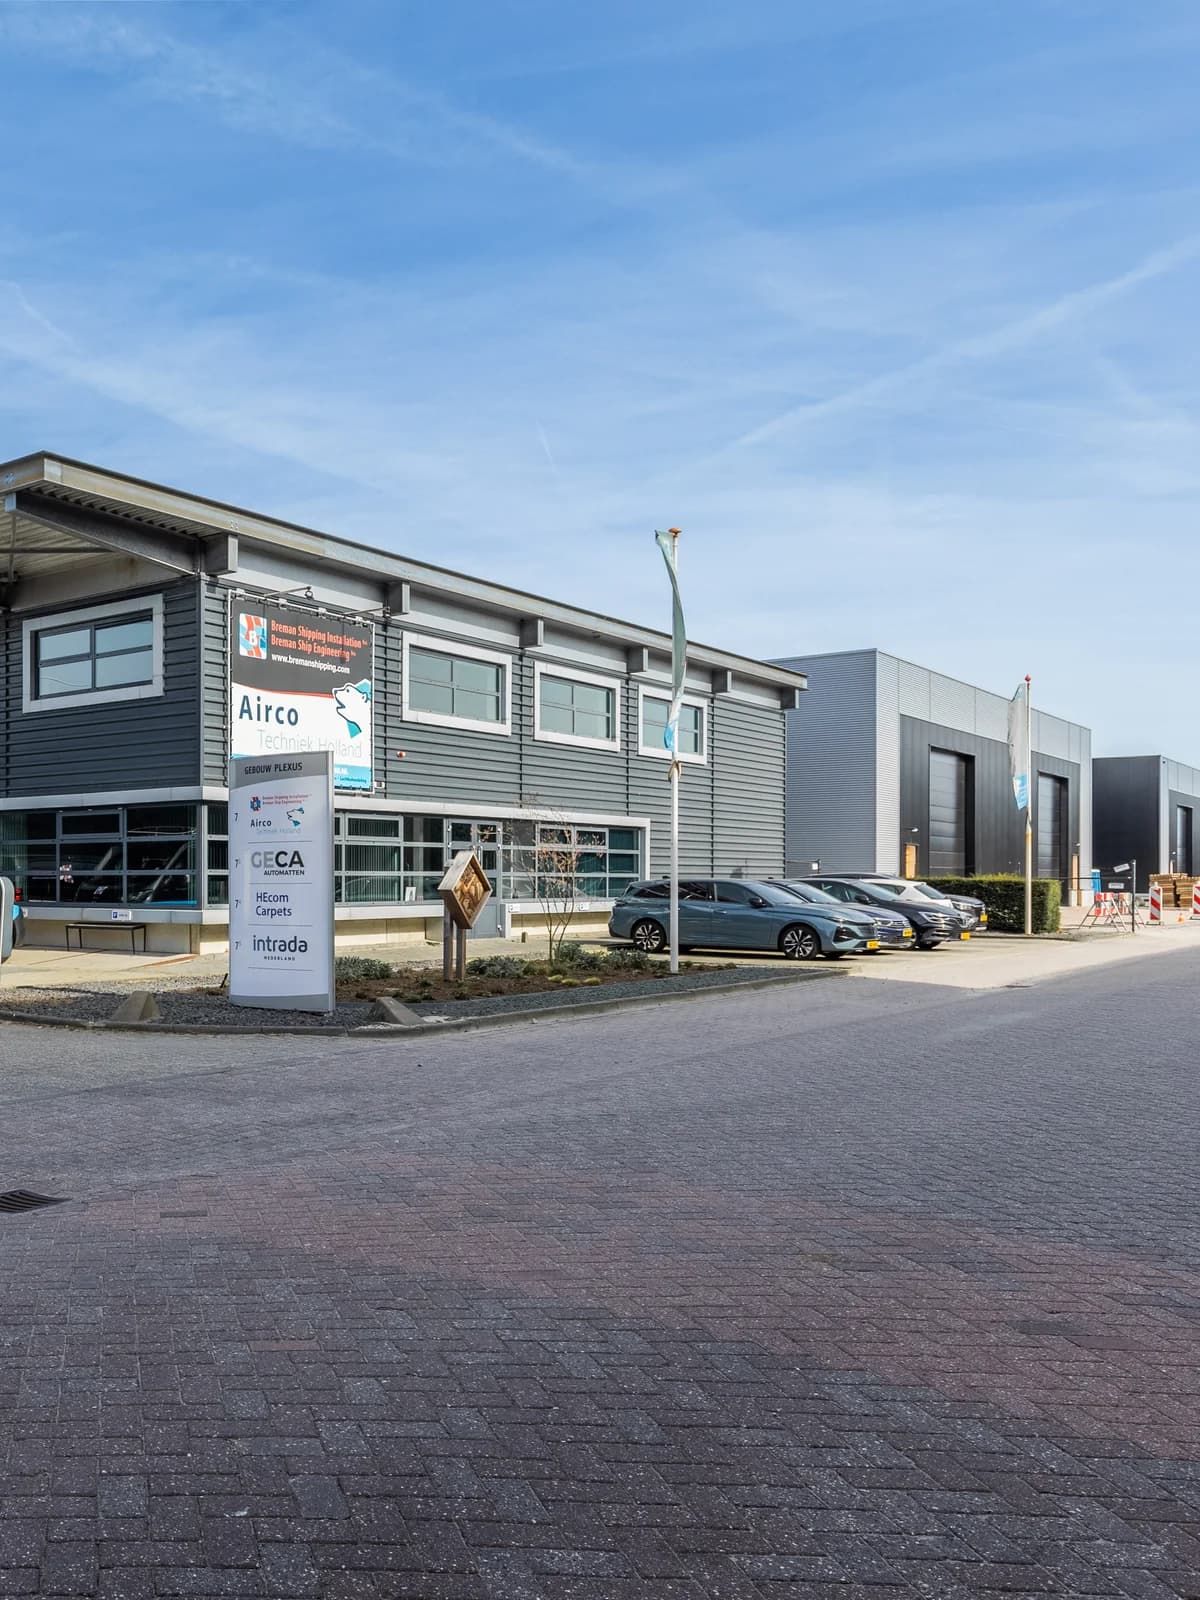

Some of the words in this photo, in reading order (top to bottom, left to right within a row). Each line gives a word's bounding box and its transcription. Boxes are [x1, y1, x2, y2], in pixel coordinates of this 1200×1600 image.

[271, 620, 297, 635] Breman
[298, 625, 326, 643] Shipping
[327, 631, 362, 648] Installation
[271, 634, 297, 649] Breman
[298, 639, 312, 654] Ship
[313, 642, 350, 662] Engineering
[271, 653, 350, 674] www.bremanshipping.com
[239, 695, 299, 726] Airco
[257, 729, 313, 752] Techniek
[319, 735, 362, 759] Holland
[244, 764, 272, 775] GEBOUW
[274, 762, 303, 772] PLEXUS
[233, 812, 239, 822] 7
[250, 819, 272, 828] Airco
[251, 850, 304, 868] GECA
[256, 892, 289, 903] HEcom
[255, 905, 292, 919] Carpets
[253, 934, 308, 953] intrada
